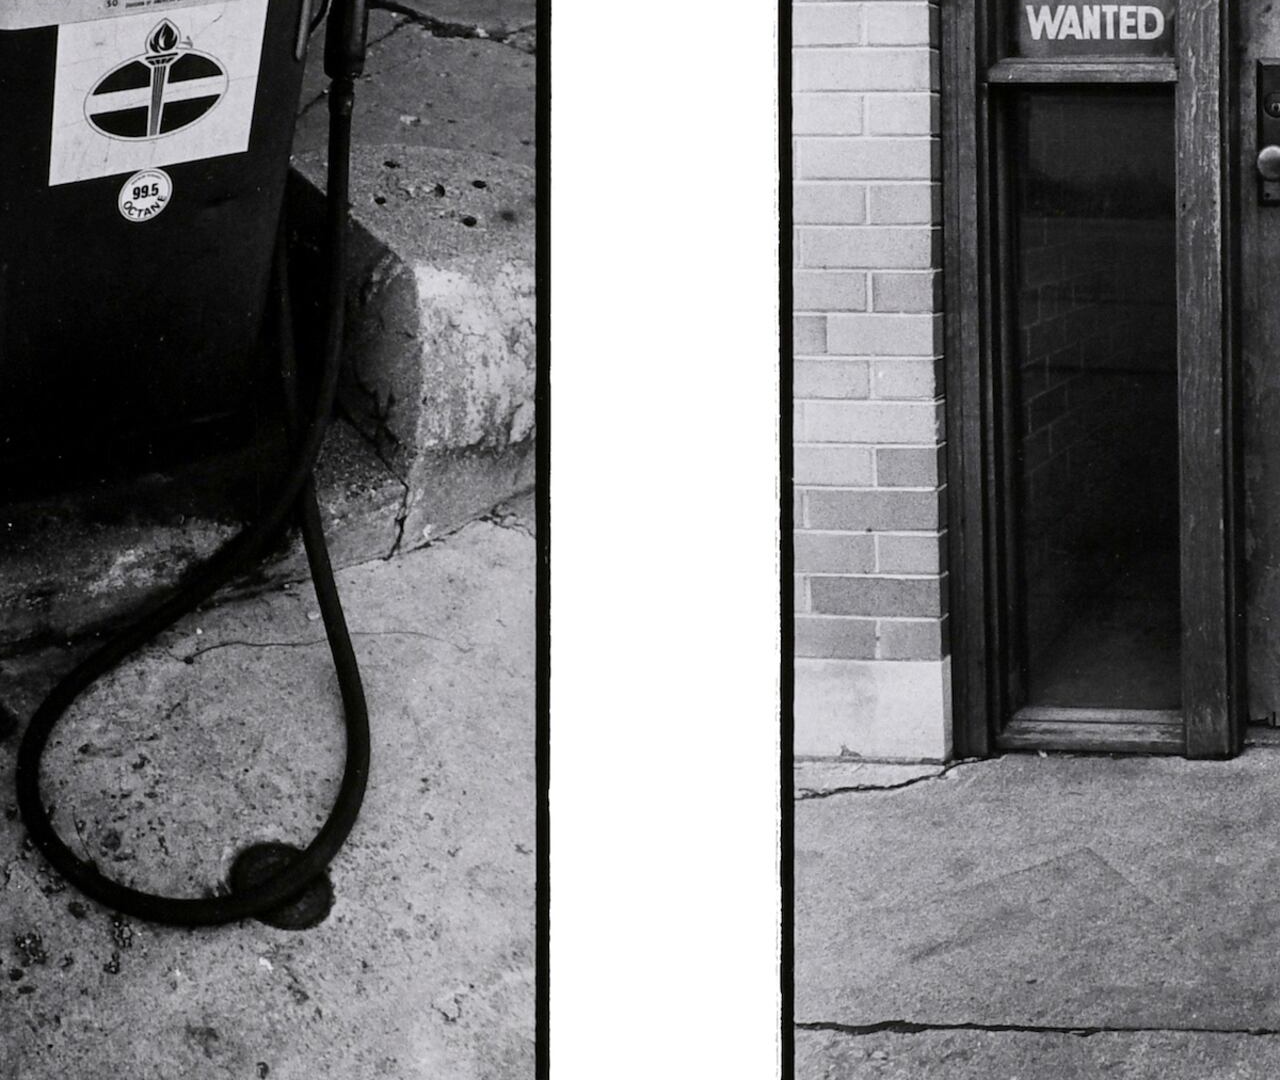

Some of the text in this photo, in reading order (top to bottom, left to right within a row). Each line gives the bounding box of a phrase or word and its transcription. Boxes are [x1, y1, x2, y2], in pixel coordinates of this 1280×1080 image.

[1025, 4, 1165, 41] WANTED
[133, 182, 159, 200] 99.5
[123, 195, 167, 218] OCTANE
